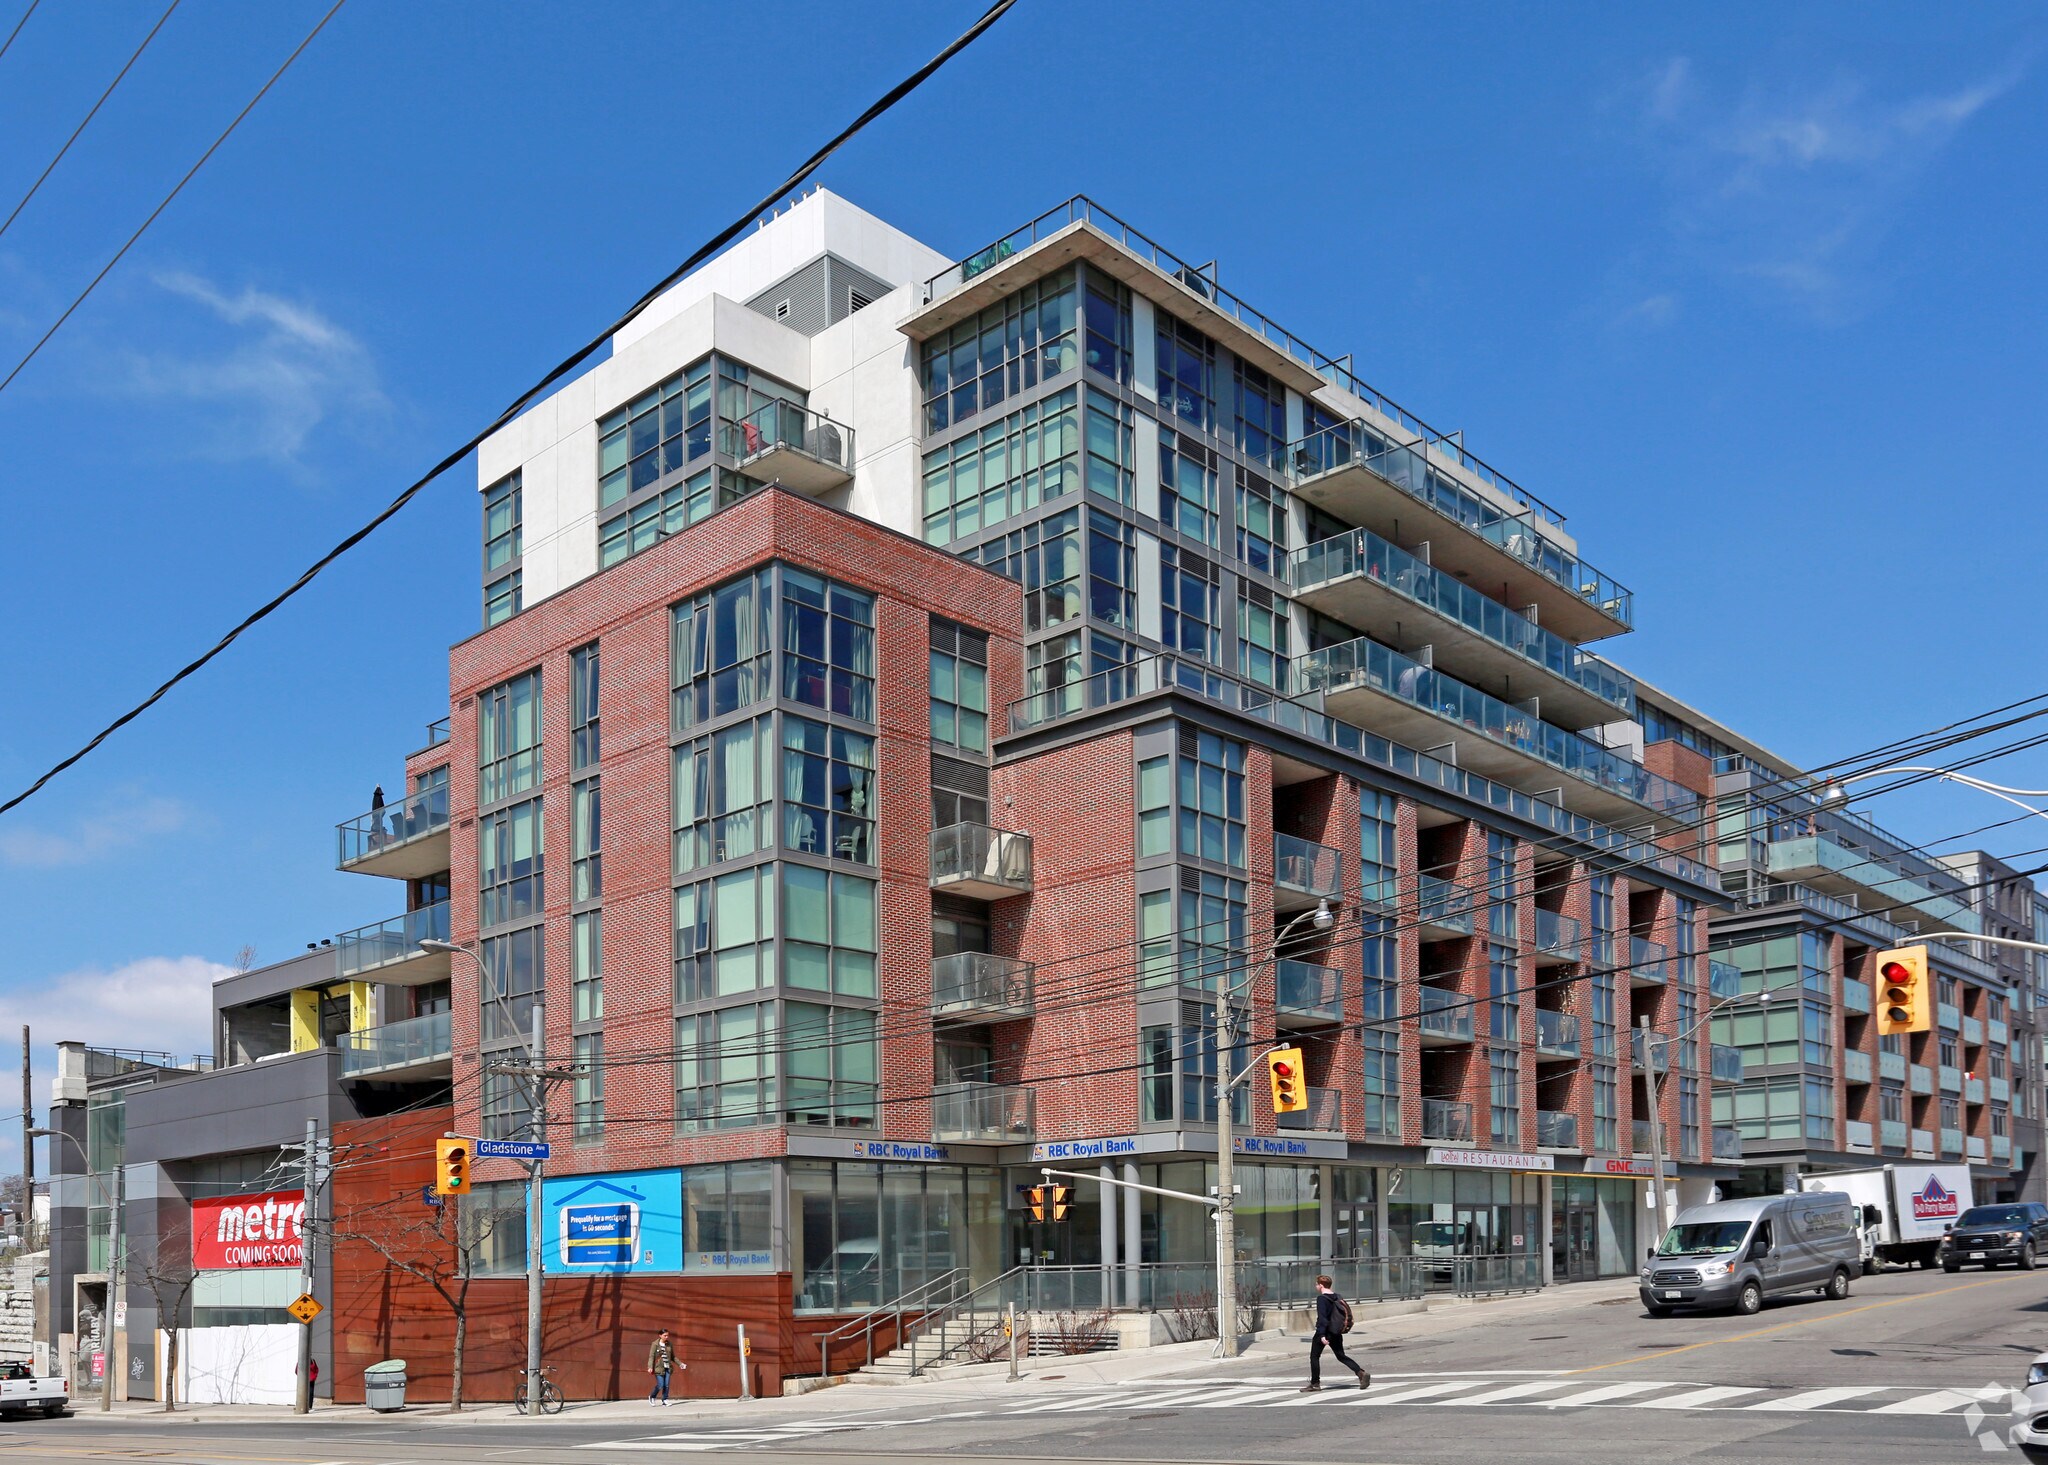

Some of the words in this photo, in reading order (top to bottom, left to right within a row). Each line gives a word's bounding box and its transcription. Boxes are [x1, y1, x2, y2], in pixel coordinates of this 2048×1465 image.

[480, 1142, 533, 1155] Gladstone
[868, 1143, 890, 1157] RBC
[893, 1144, 921, 1160] Royal
[924, 1146, 949, 1159] Bank
[1048, 1144, 1070, 1157] RBC
[1073, 1141, 1103, 1158] Royal
[1106, 1138, 1136, 1153] Bank
[1245, 1138, 1261, 1152] RBC
[1263, 1140, 1285, 1154] Royal
[1287, 1141, 1307, 1154] Bank
[1463, 1152, 1536, 1167] RESTAURANT
[1606, 1160, 1633, 1172] GNC
[605, 1214, 628, 1222] mortgage
[225, 1244, 270, 1264] COMING
[729, 1253, 750, 1266] Royal
[751, 1252, 770, 1264] Bank
